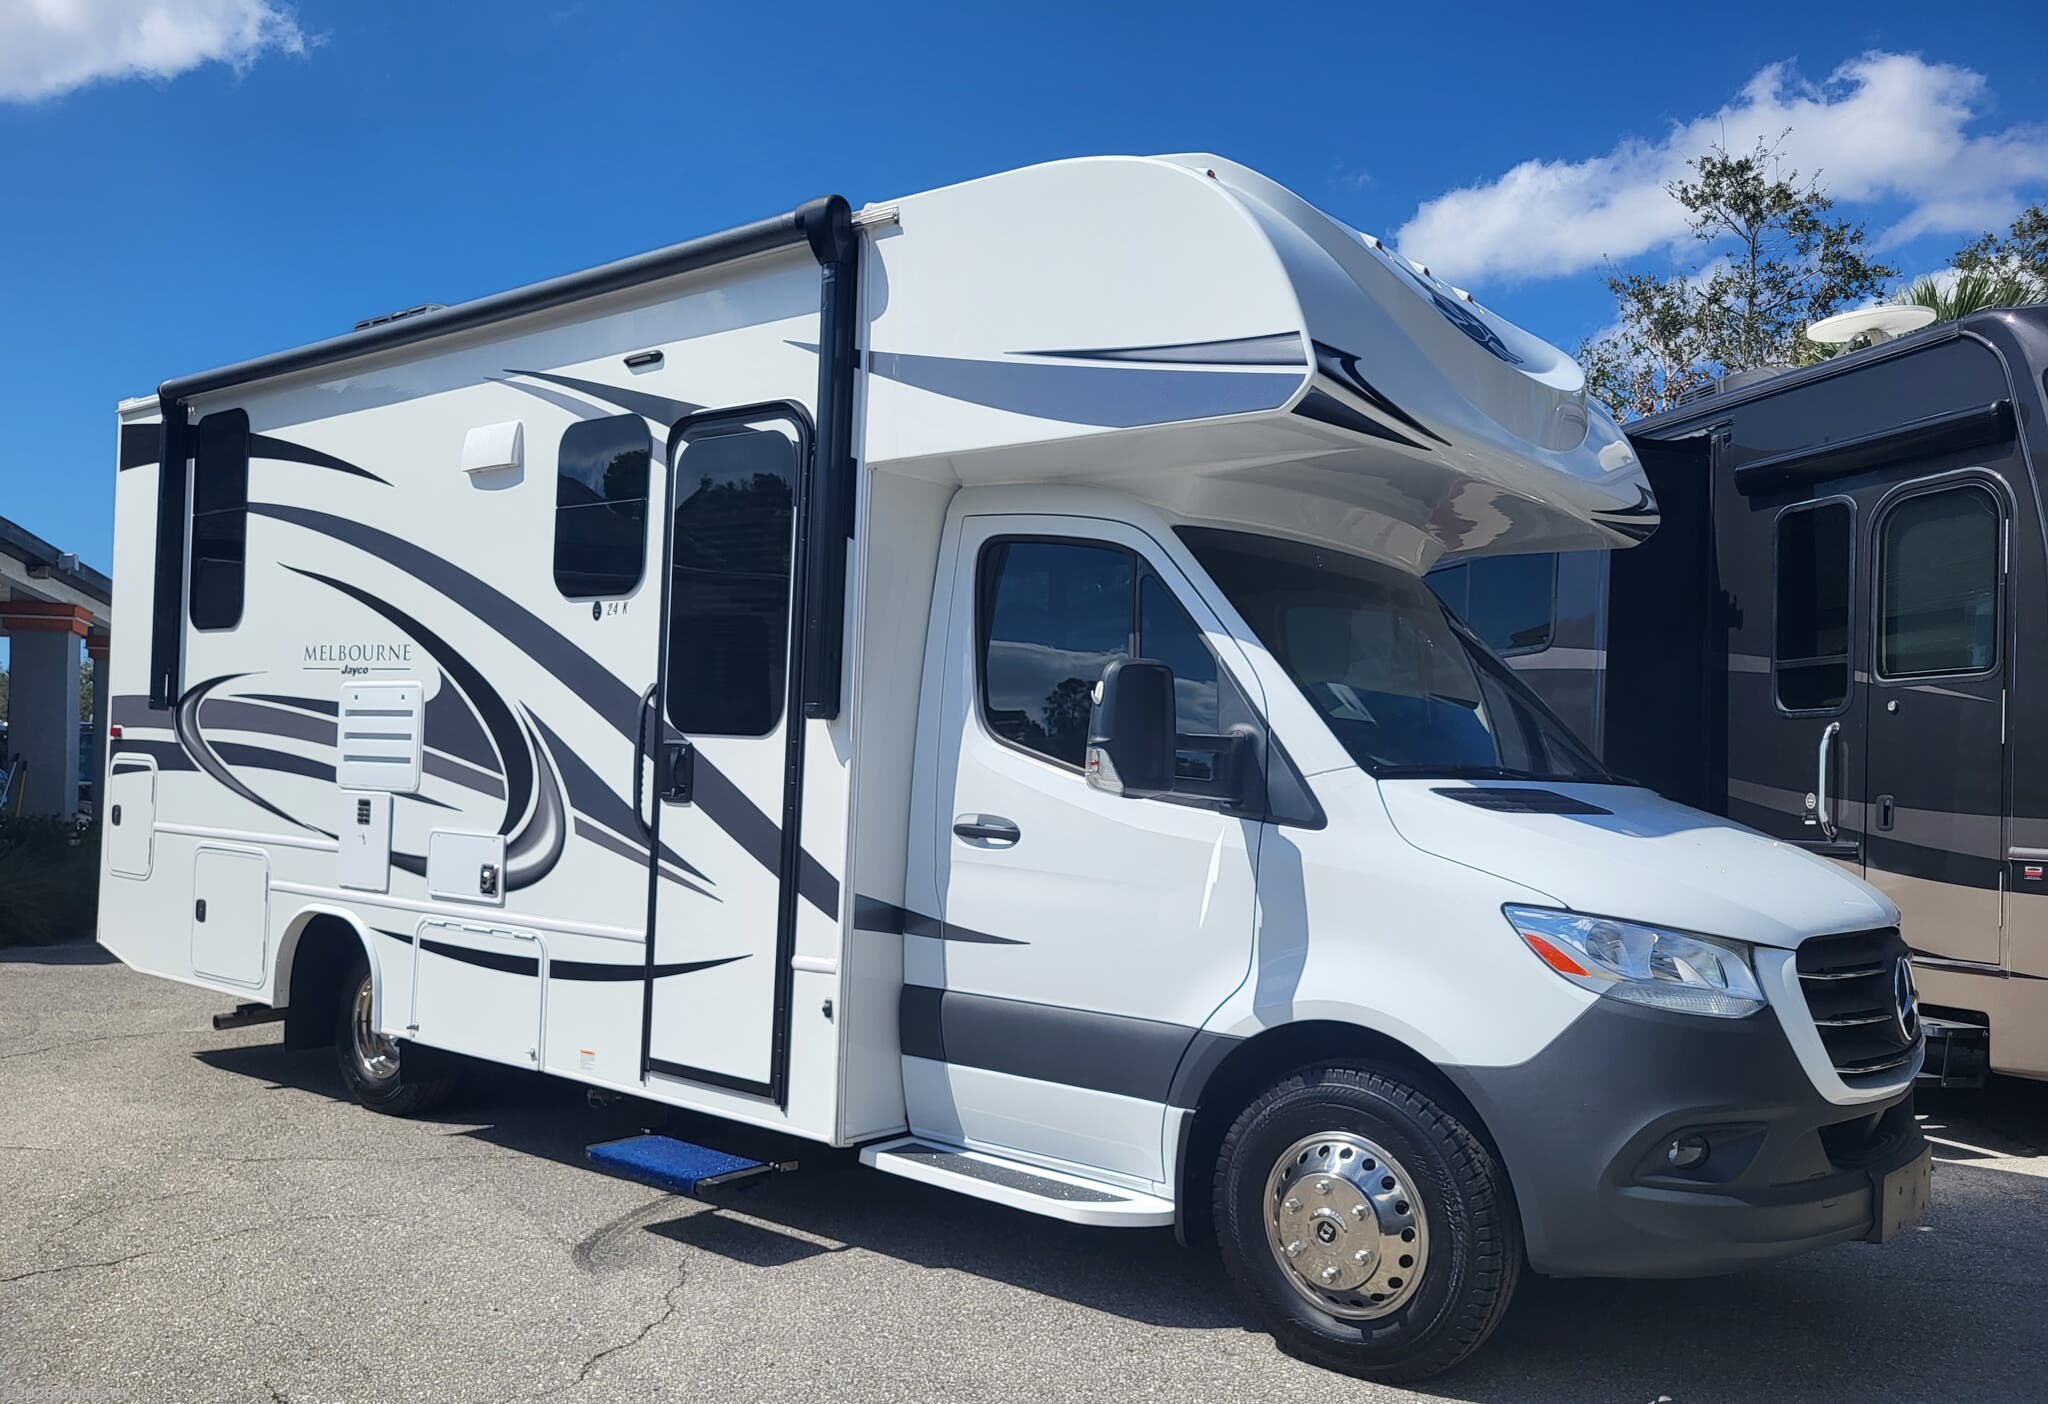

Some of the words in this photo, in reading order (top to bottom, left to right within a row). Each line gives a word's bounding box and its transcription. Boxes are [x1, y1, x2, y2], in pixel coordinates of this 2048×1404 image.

[607, 602, 619, 616] 24
[303, 644, 412, 661] MELBOURNE
[341, 664, 369, 676] Jayco
